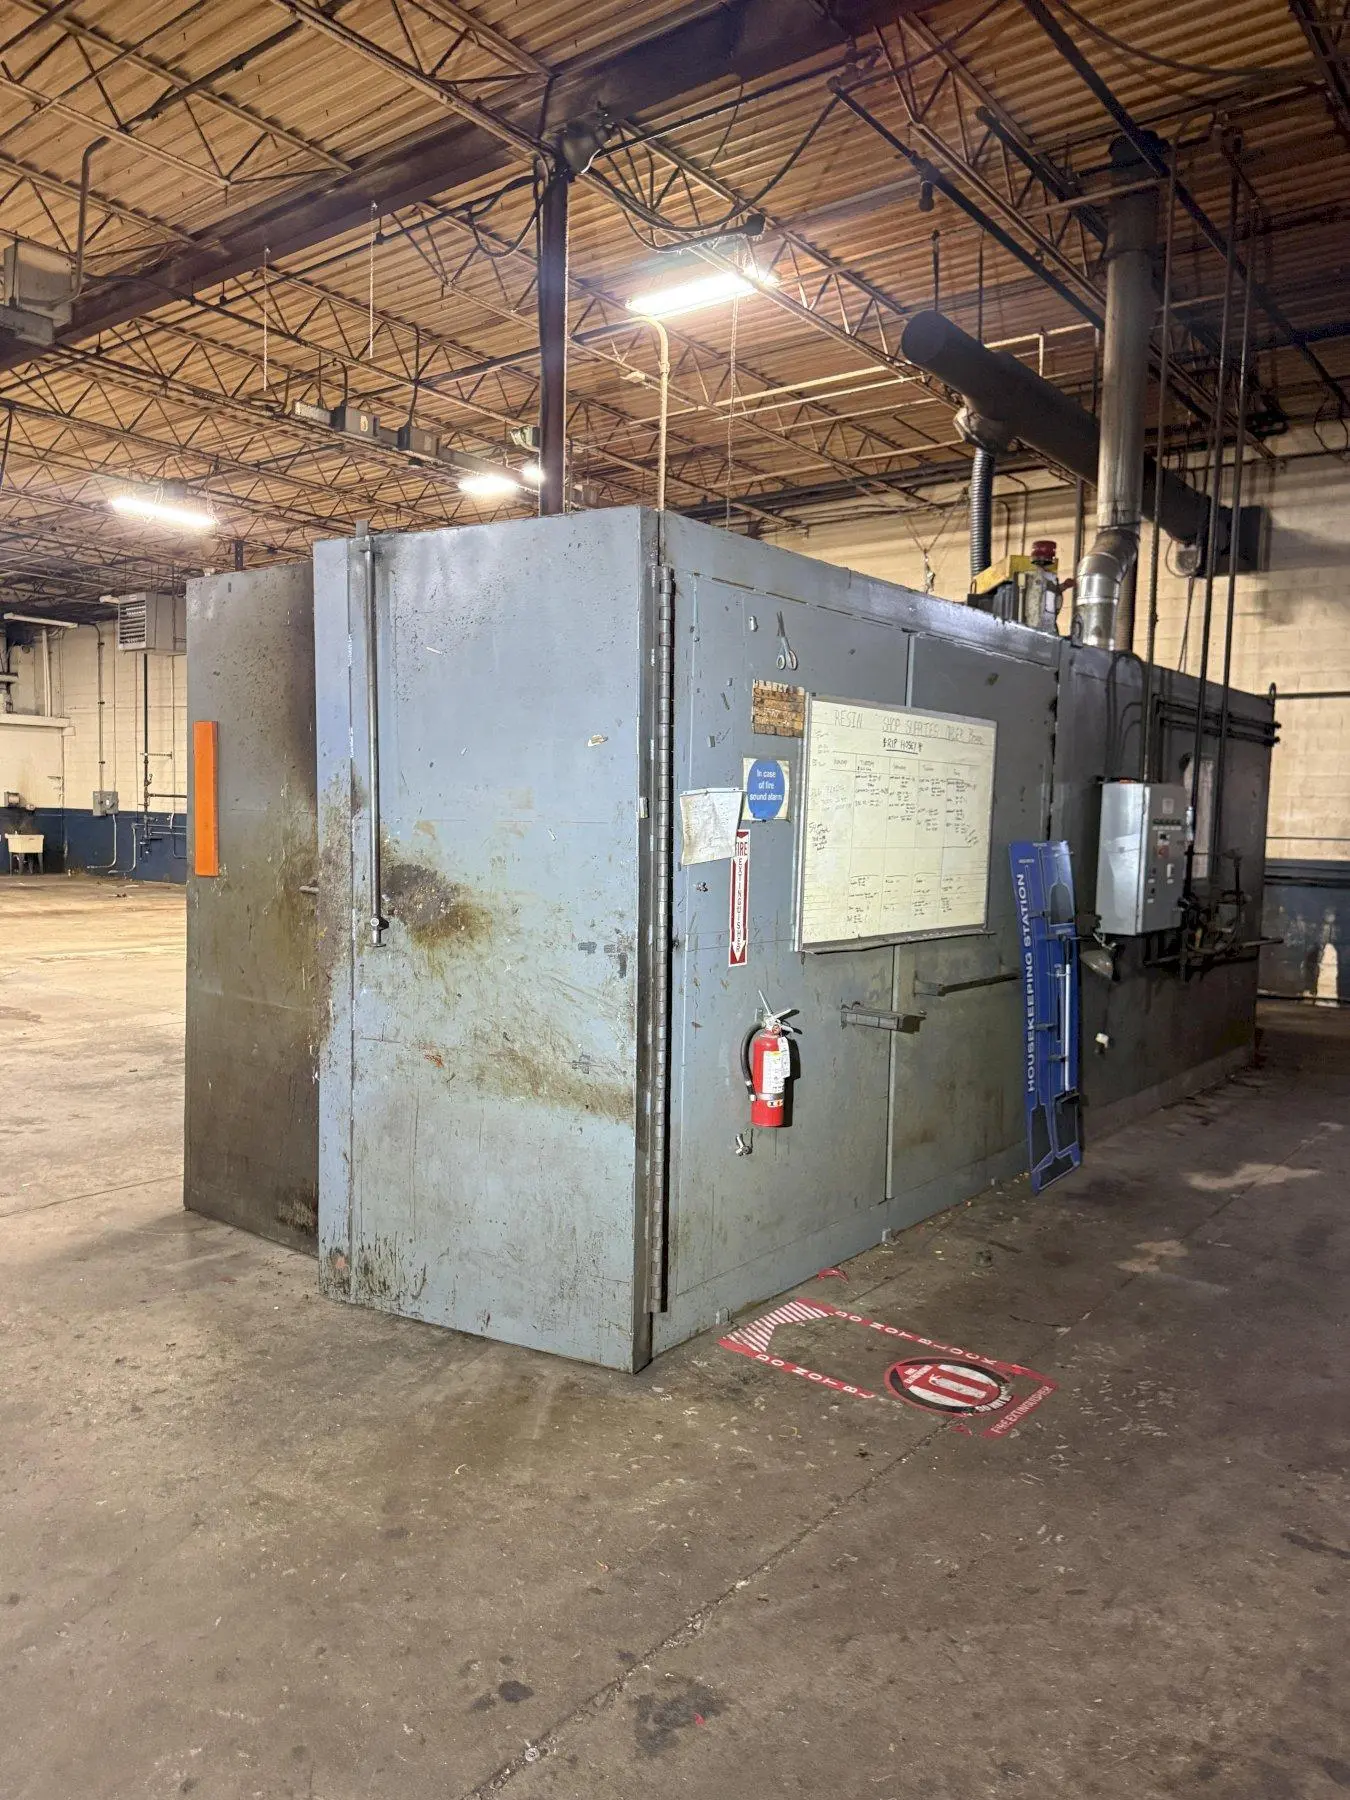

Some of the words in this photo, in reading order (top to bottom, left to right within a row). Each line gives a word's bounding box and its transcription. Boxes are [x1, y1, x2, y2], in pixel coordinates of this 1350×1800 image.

[834, 709, 864, 729] RESIN
[756, 769, 763, 778] In
[763, 770, 777, 778] case
[758, 780, 765, 789] of
[765, 780, 775, 789] fire
[749, 793, 767, 801] sound
[767, 793, 783, 801] alarm
[735, 857, 743, 952] EXTINGUISHER
[1016, 873, 1032, 948] STATION
[1024, 951, 1036, 1093] HOUSEKEEPING
[834, 1310, 862, 1323] DO
[869, 1321, 914, 1339] NOT
[917, 1337, 998, 1365] BLOCK
[755, 1354, 785, 1367] DO
[792, 1366, 838, 1386] NOT
[990, 1418, 1014, 1435] FIRE
[1005, 1384, 1055, 1423] EXTINGUISHER
